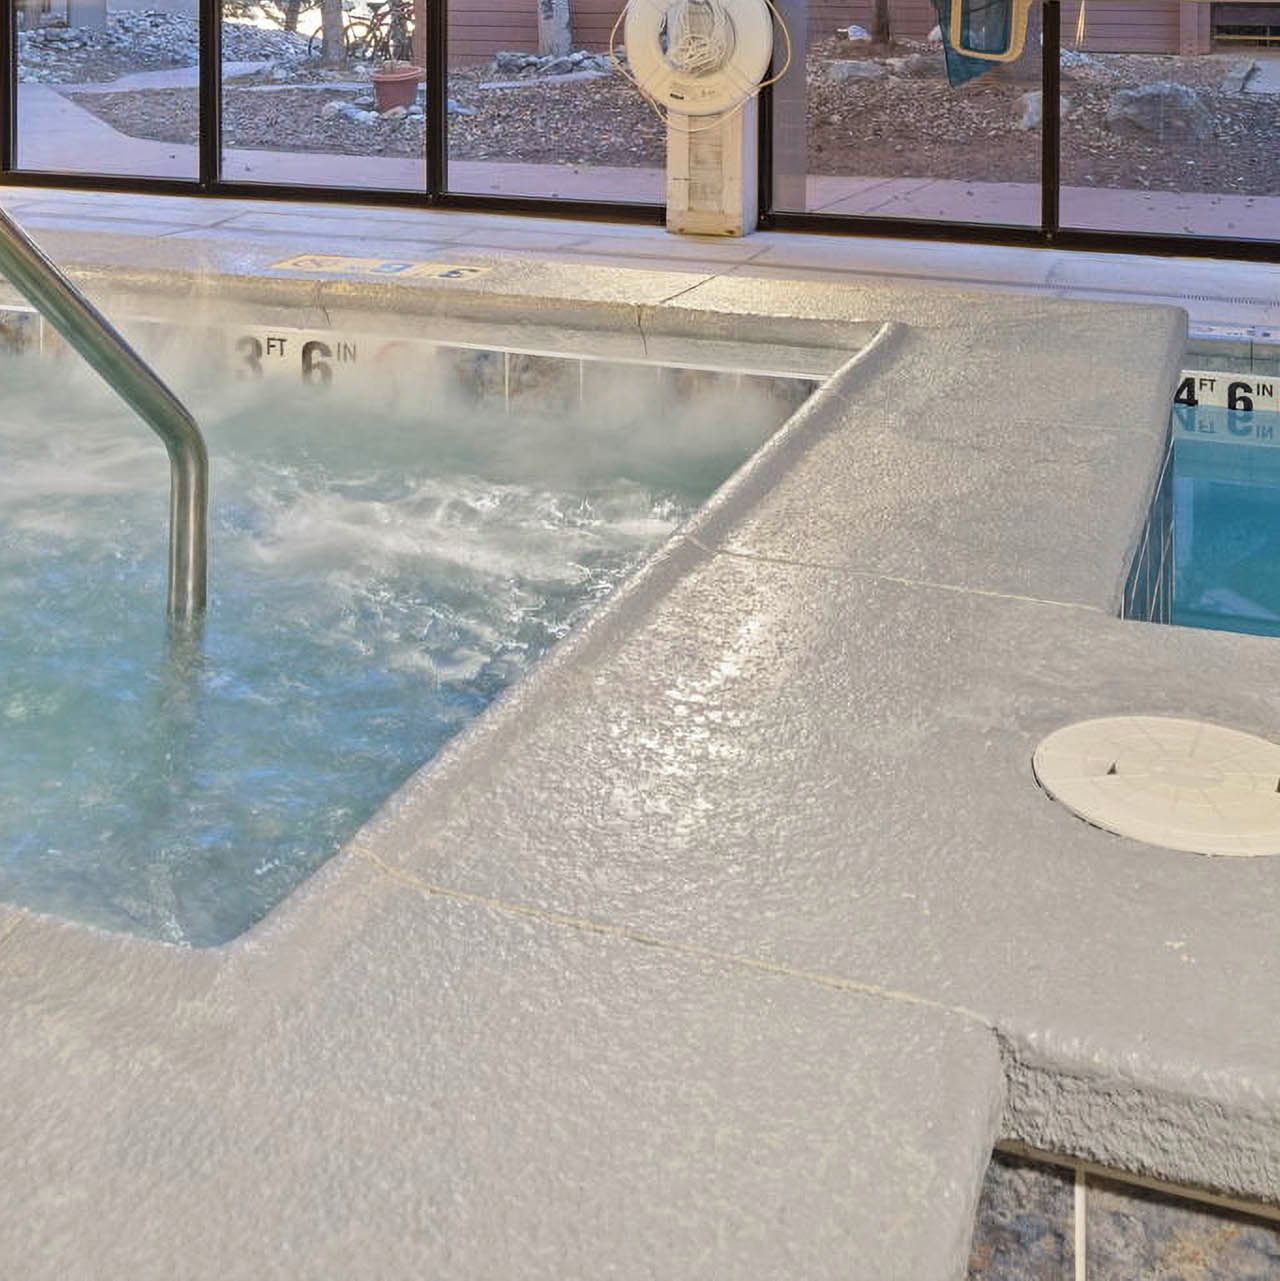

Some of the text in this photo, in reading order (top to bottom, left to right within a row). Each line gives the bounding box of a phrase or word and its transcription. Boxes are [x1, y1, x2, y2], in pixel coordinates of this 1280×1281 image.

[235, 335, 357, 386] 3 FT 6 IN
[1173, 377, 1273, 411] 4 FT 6 IN
